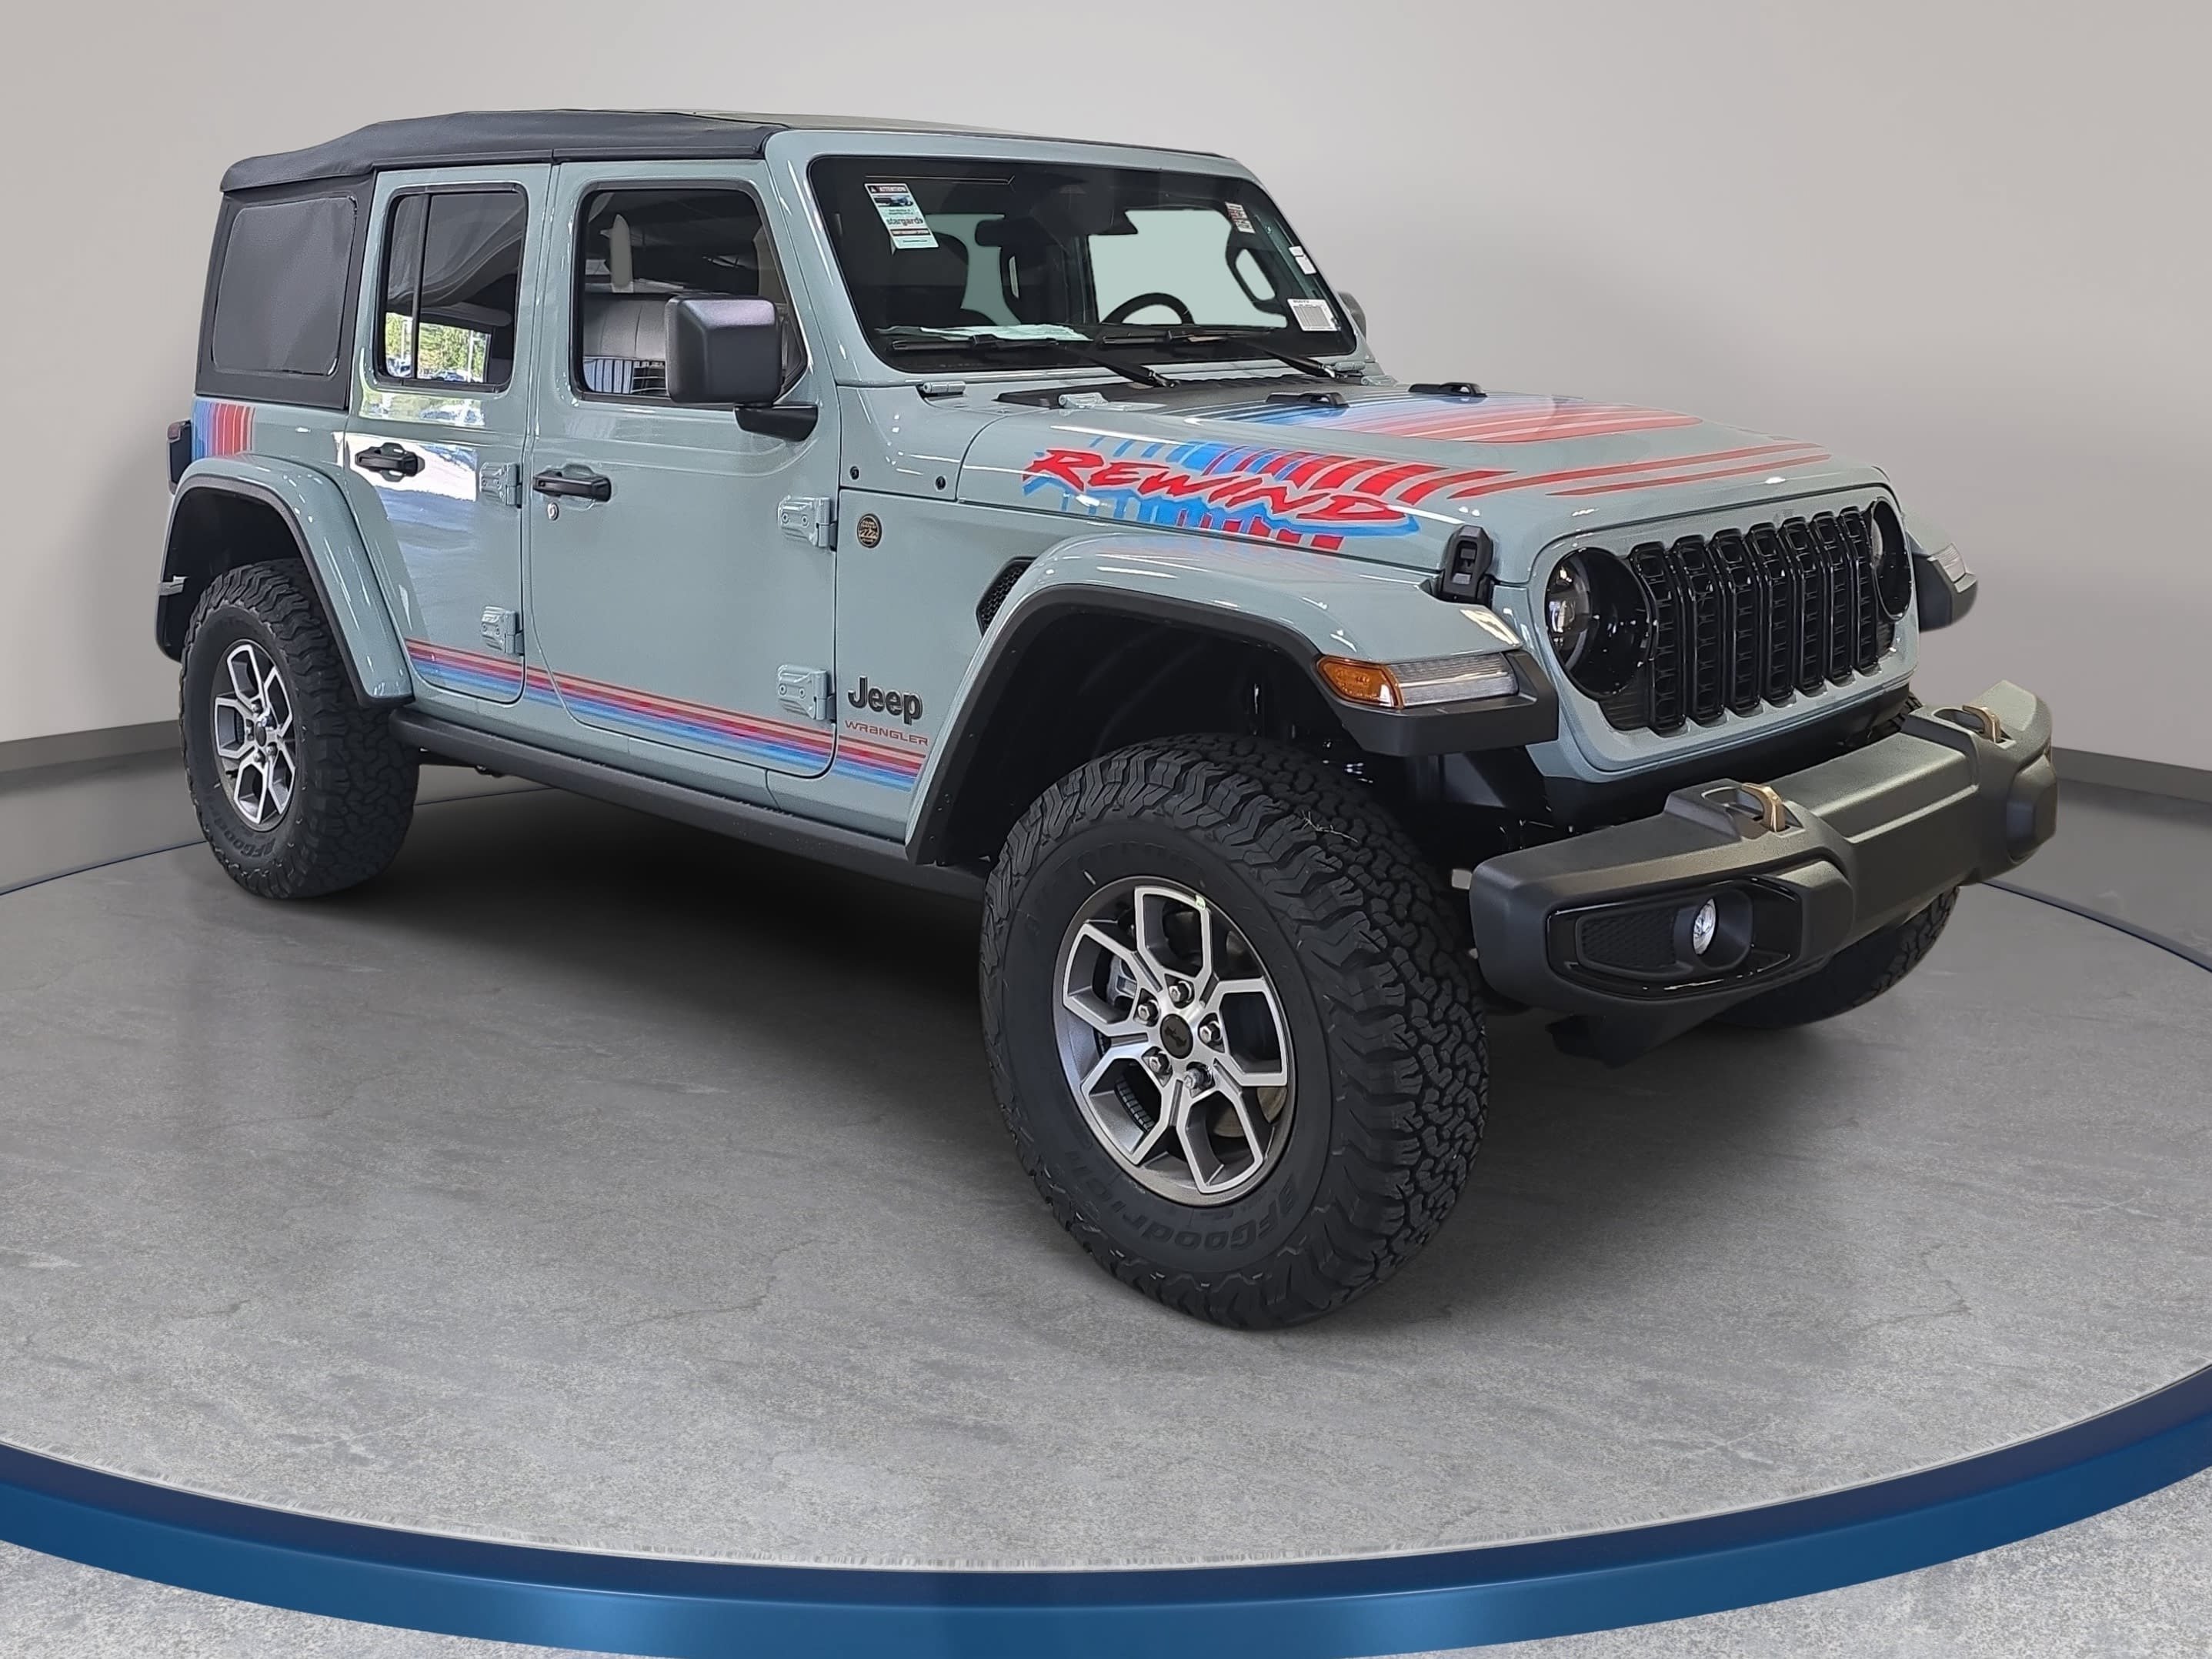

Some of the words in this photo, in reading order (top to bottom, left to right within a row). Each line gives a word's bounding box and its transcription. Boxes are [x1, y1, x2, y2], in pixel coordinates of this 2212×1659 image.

[1022, 449, 1408, 522] REWIND
[848, 675, 923, 726] Jeep
[845, 720, 928, 746] WRANGLER
